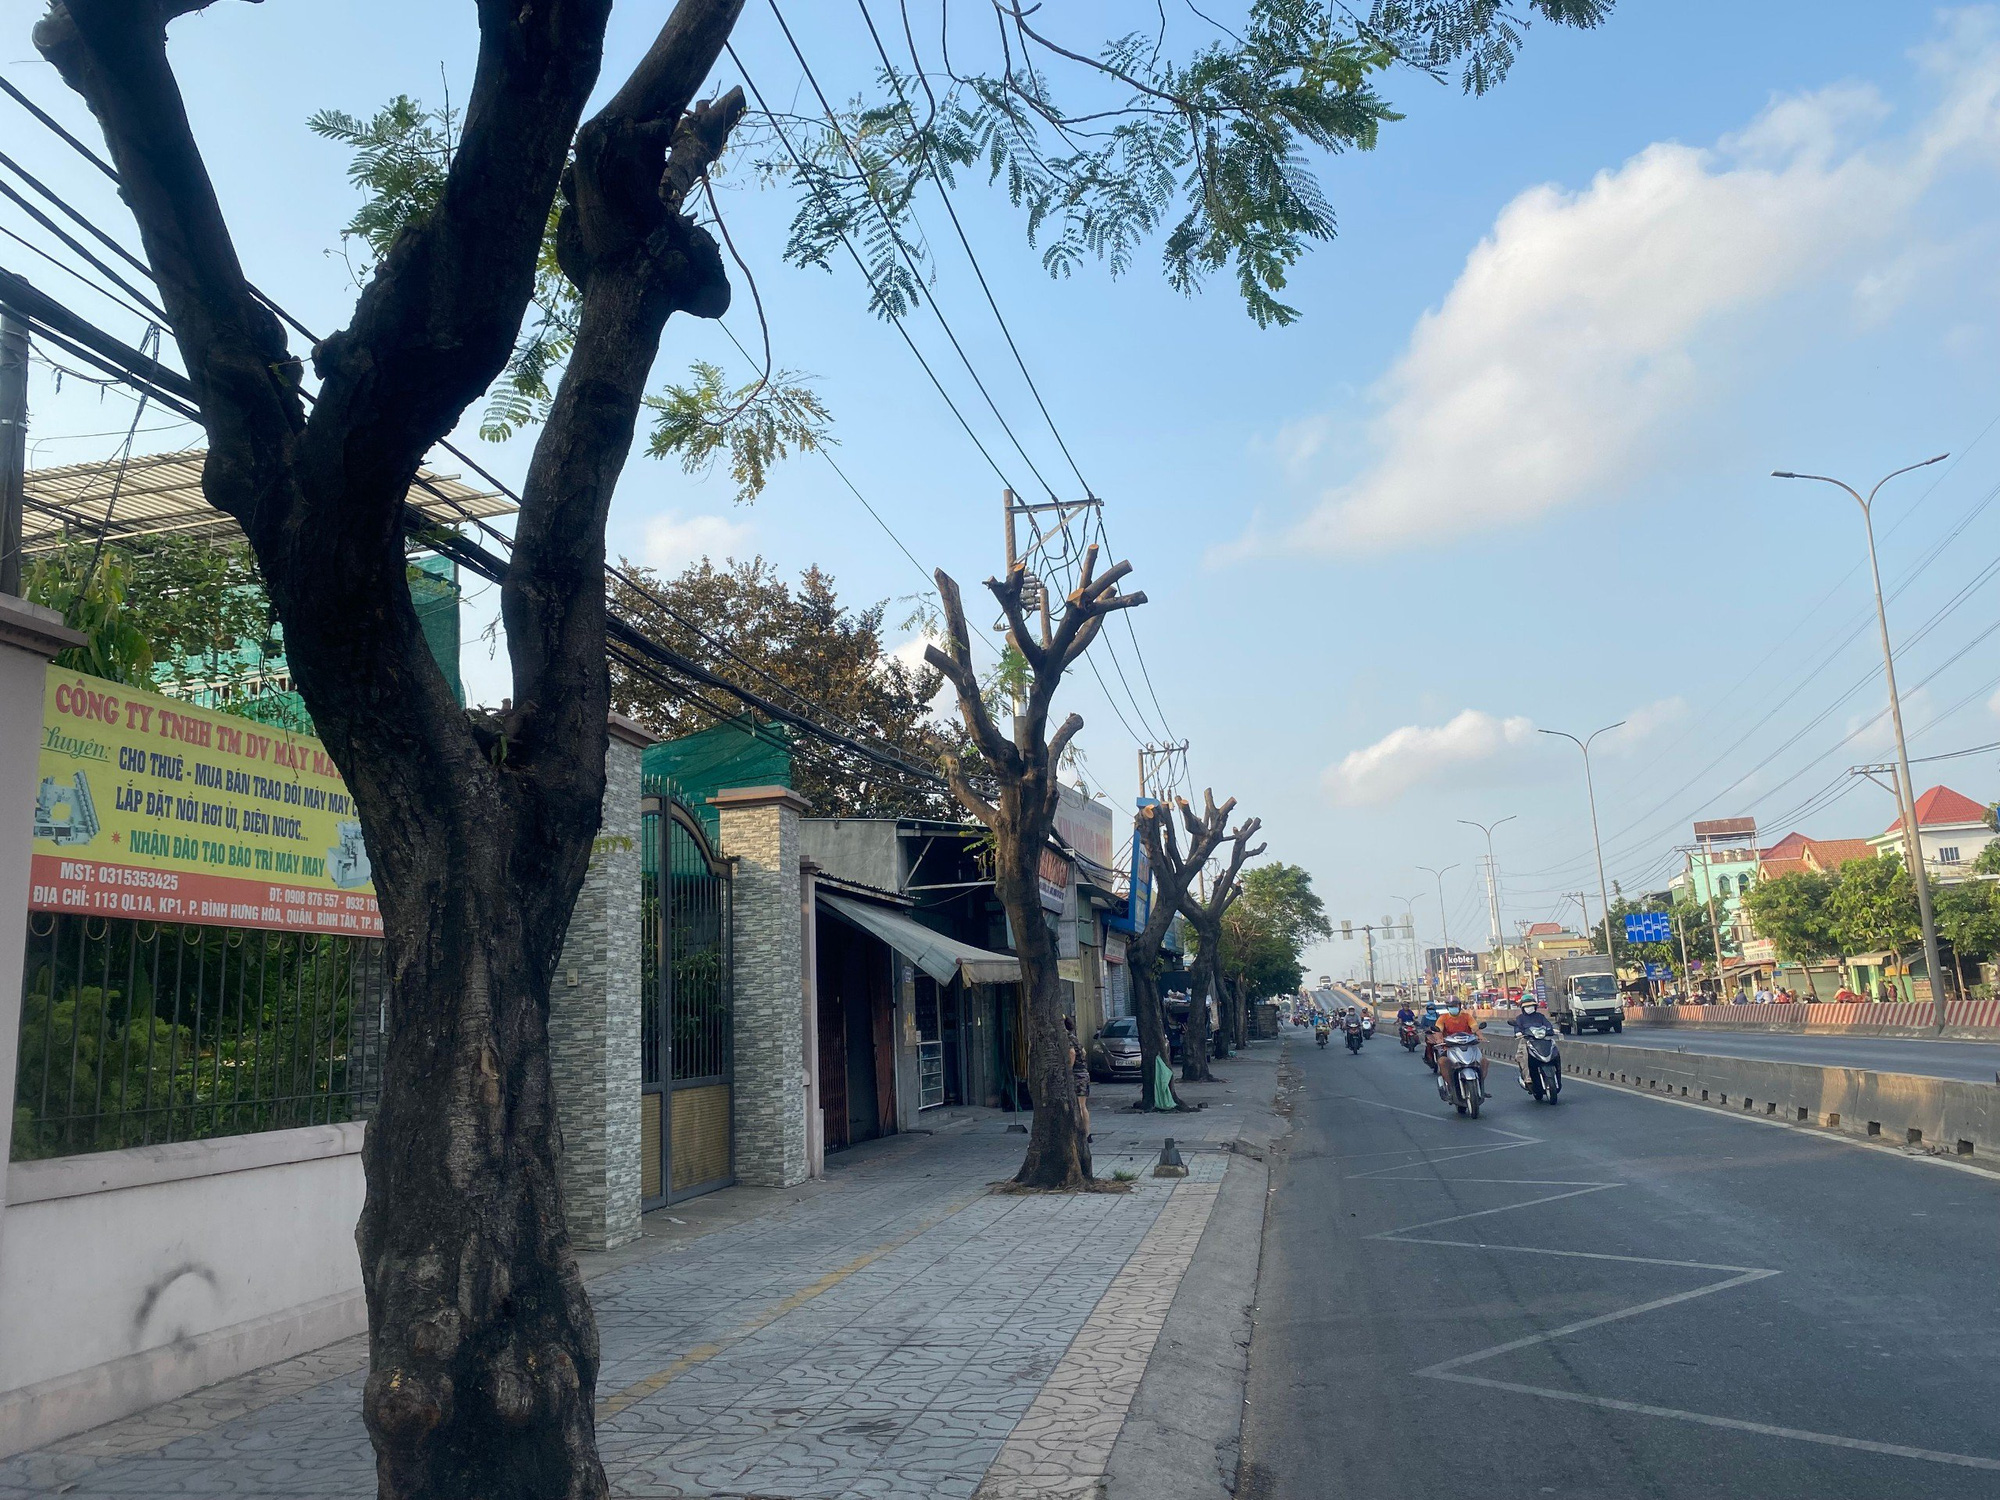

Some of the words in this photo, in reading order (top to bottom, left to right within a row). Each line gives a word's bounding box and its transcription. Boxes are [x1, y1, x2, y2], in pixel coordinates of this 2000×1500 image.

[56, 679, 120, 725] CÔNG
[124, 701, 154, 733] TY
[158, 709, 213, 748] TNHH
[216, 725, 243, 755] TM
[245, 733, 271, 761] DV
[274, 738, 310, 771] MÁY
[313, 750, 343, 779] MA
[119, 746, 146, 773] CHO
[149, 754, 184, 781] THUÊ
[194, 762, 223, 790] MUA
[225, 768, 251, 796] BÁN
[253, 775, 282, 802] TRAO
[304, 785, 327, 811] MÁY
[328, 792, 351, 816] MAY
[115, 779, 143, 813] LẮP
[146, 789, 174, 821] ĐẶT
[175, 791, 199, 823] NỒI
[201, 802, 223, 827] HƠI
[225, 801, 240, 834] ỦI,
[243, 808, 270, 837] ĐIỆN
[60, 862, 95, 882] MST:
[98, 866, 179, 891] 0315353425
[129, 829, 171, 860] NHẬN
[173, 834, 199, 861] ĐÀO
[202, 840, 226, 868] TẠO
[229, 841, 252, 868] BẢO
[255, 847, 273, 871] TRÌ
[275, 850, 300, 875] MÁY
[302, 856, 325, 877] MAY
[33, 885, 58, 907] ĐỊA
[62, 885, 90, 907] CHỈ:
[94, 891, 118, 909] 113
[121, 893, 156, 914] QL1A,
[159, 897, 186, 916] KP1,
[188, 900, 198, 916] P.
[201, 899, 228, 918] BÌNH
[230, 904, 259, 921] HƯNG
[261, 905, 284, 924] HÒA,
[286, 910, 315, 928] QUẬN.
[317, 910, 338, 927] BÌNH
[340, 912, 359, 931] TÂN,
[361, 916, 372, 931] TP.
[269, 887, 283, 902] ĐT:
[284, 889, 306, 905] 0908
[307, 891, 323, 906] 876
[324, 894, 339, 908] 557
[346, 896, 365, 911] 0932
[1448, 955, 1474, 963] kobler
